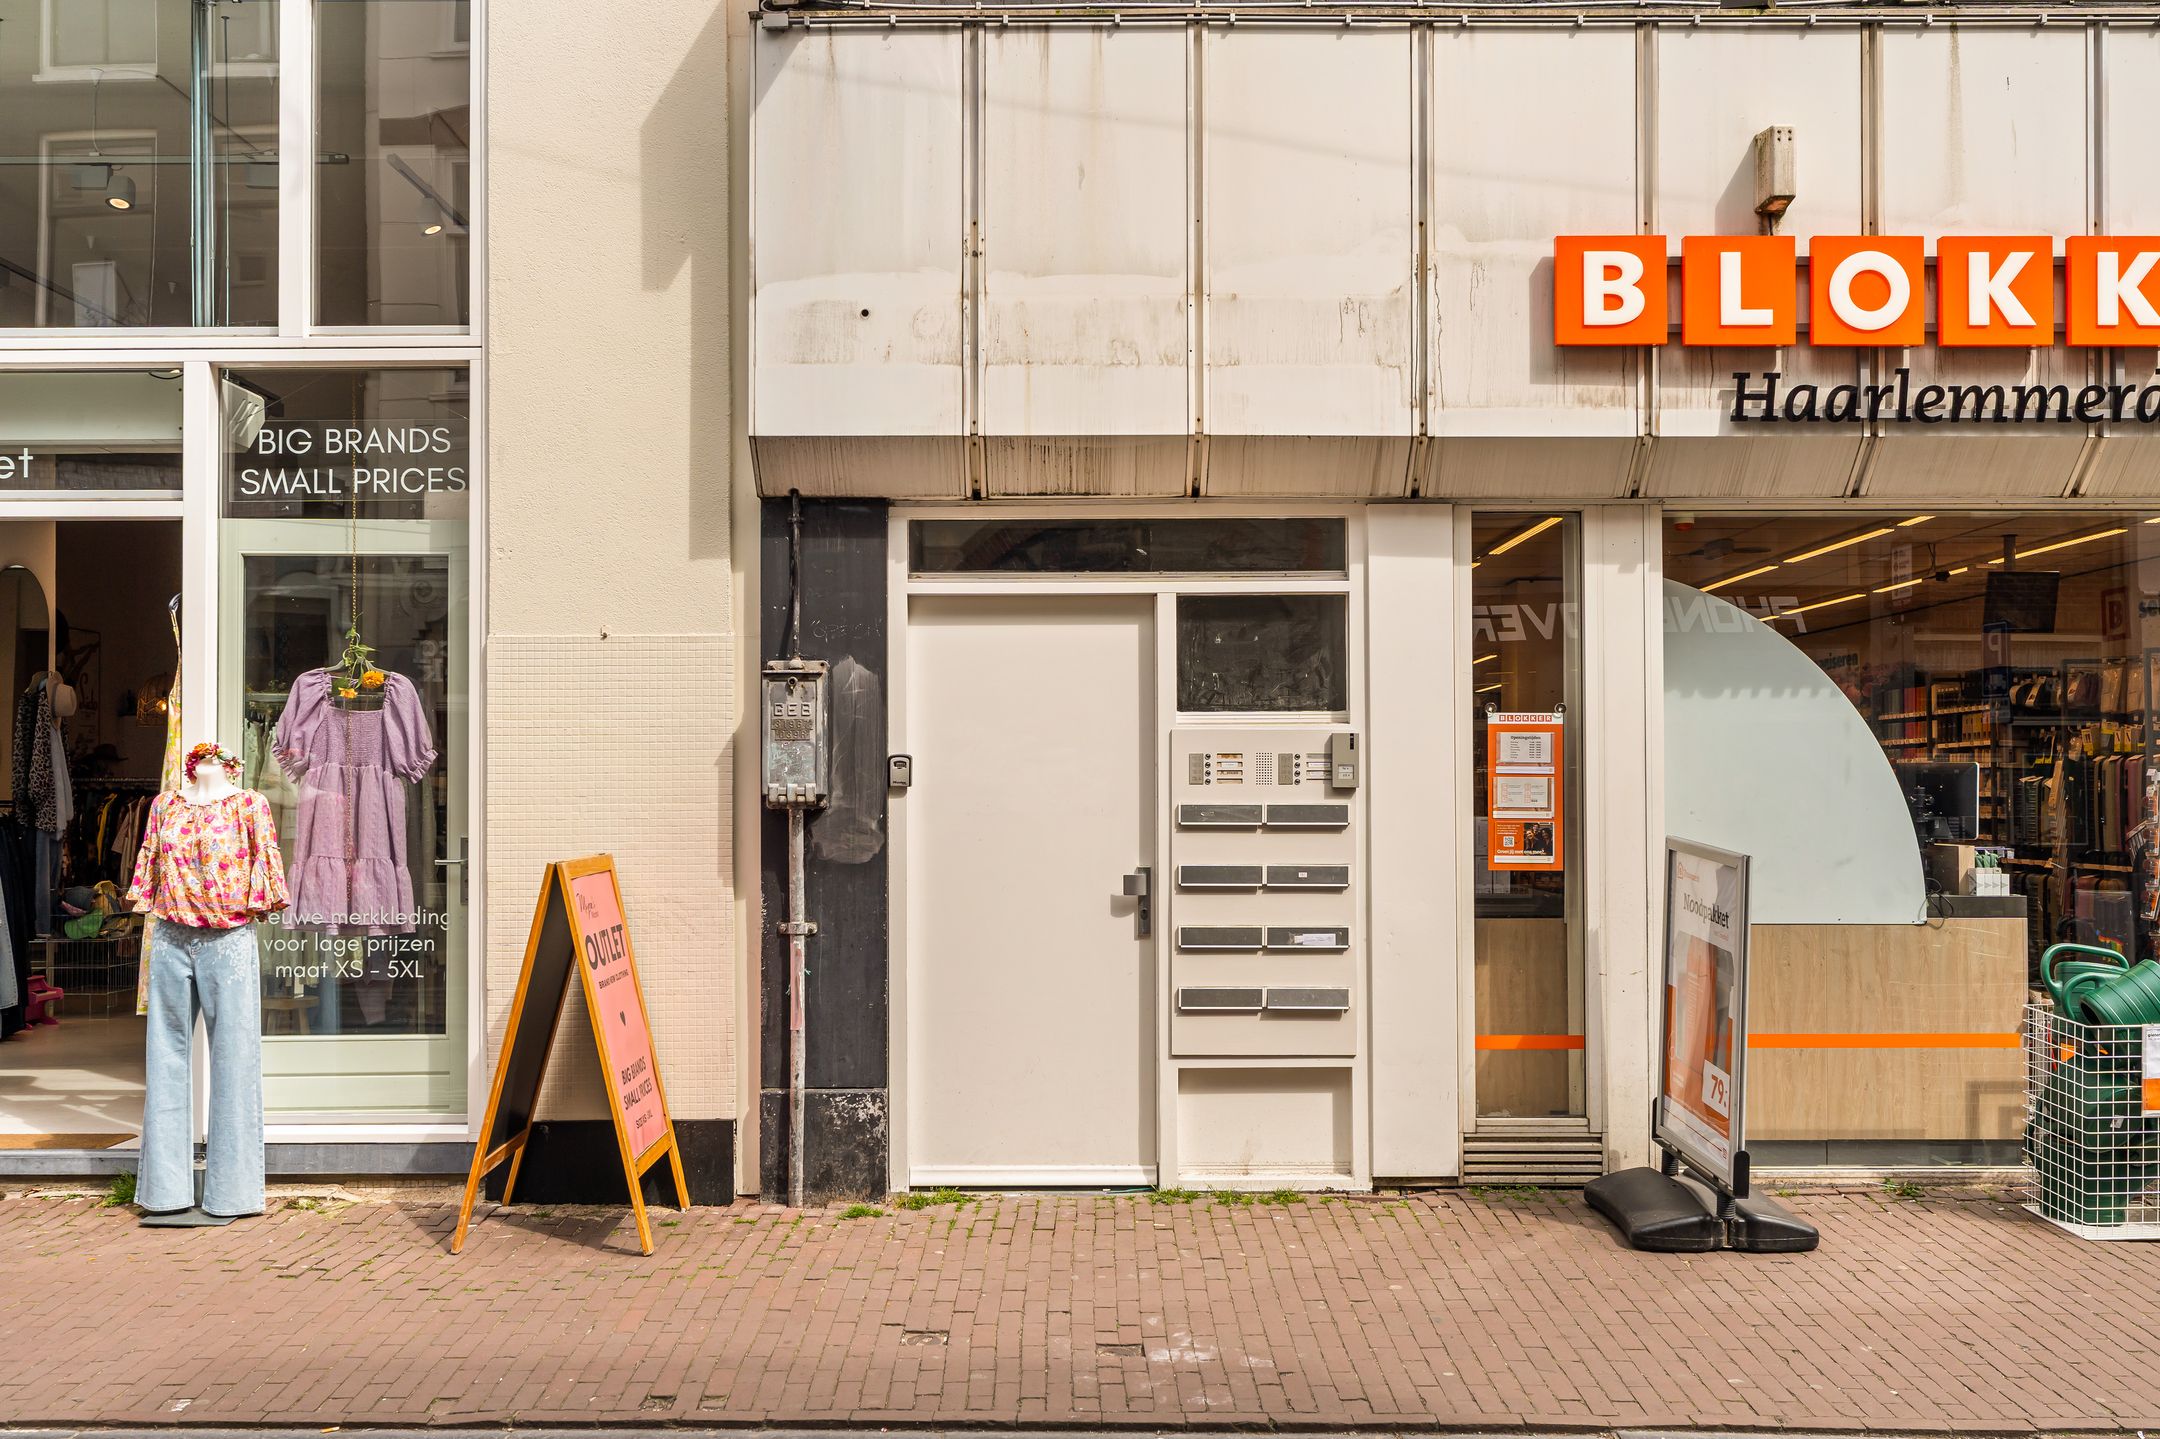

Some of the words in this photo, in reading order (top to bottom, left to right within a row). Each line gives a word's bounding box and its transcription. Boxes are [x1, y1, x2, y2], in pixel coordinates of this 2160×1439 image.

[1582, 250, 2160, 330] BLOKK
[258, 428, 312, 455] BIG
[326, 427, 451, 454] BRANDS
[240, 469, 341, 495] SMALL
[354, 467, 466, 494] PRICES
[773, 702, 811, 717] GEB
[1499, 714, 1552, 722] BLOKKER
[255, 912, 324, 926] euwe
[331, 906, 450, 930] merkkleding
[1683, 893, 1730, 929] Noodpakket
[264, 938, 308, 952] voor
[315, 932, 360, 957] lage
[367, 936, 435, 957] prijzen
[585, 924, 625, 970] OUTLET
[275, 961, 329, 978] maat
[335, 961, 364, 978] XS
[387, 960, 424, 978] 5XL
[621, 1067, 632, 1085] BIG
[623, 1087, 641, 1111] SMALL
